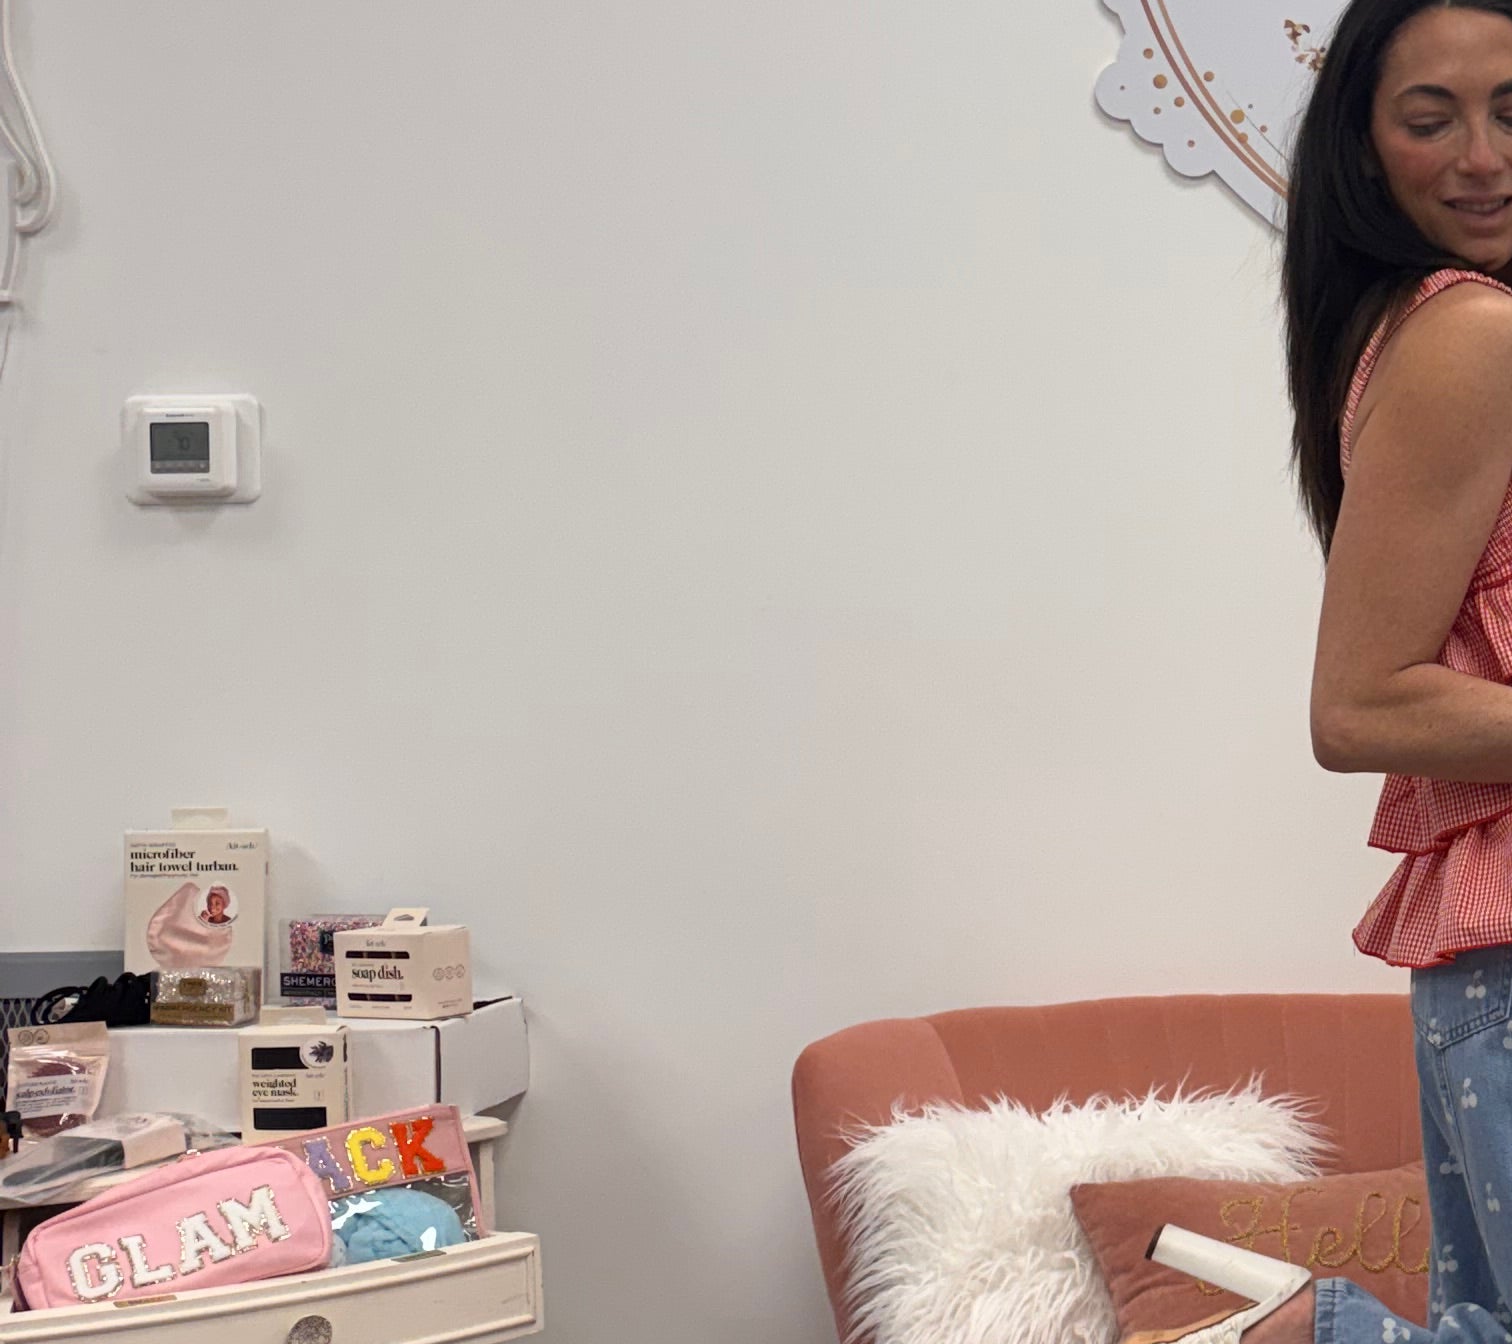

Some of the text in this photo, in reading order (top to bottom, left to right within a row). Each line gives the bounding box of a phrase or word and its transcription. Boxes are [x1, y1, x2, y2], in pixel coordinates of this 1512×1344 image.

[130, 848, 196, 860] microfiber
[130, 861, 155, 872] hair
[159, 861, 192, 872] towel
[351, 967, 376, 982] soap
[303, 1116, 446, 1194] ACK
[65, 1183, 292, 1304] GLAM
[1196, 1187, 1430, 1296] Hell
